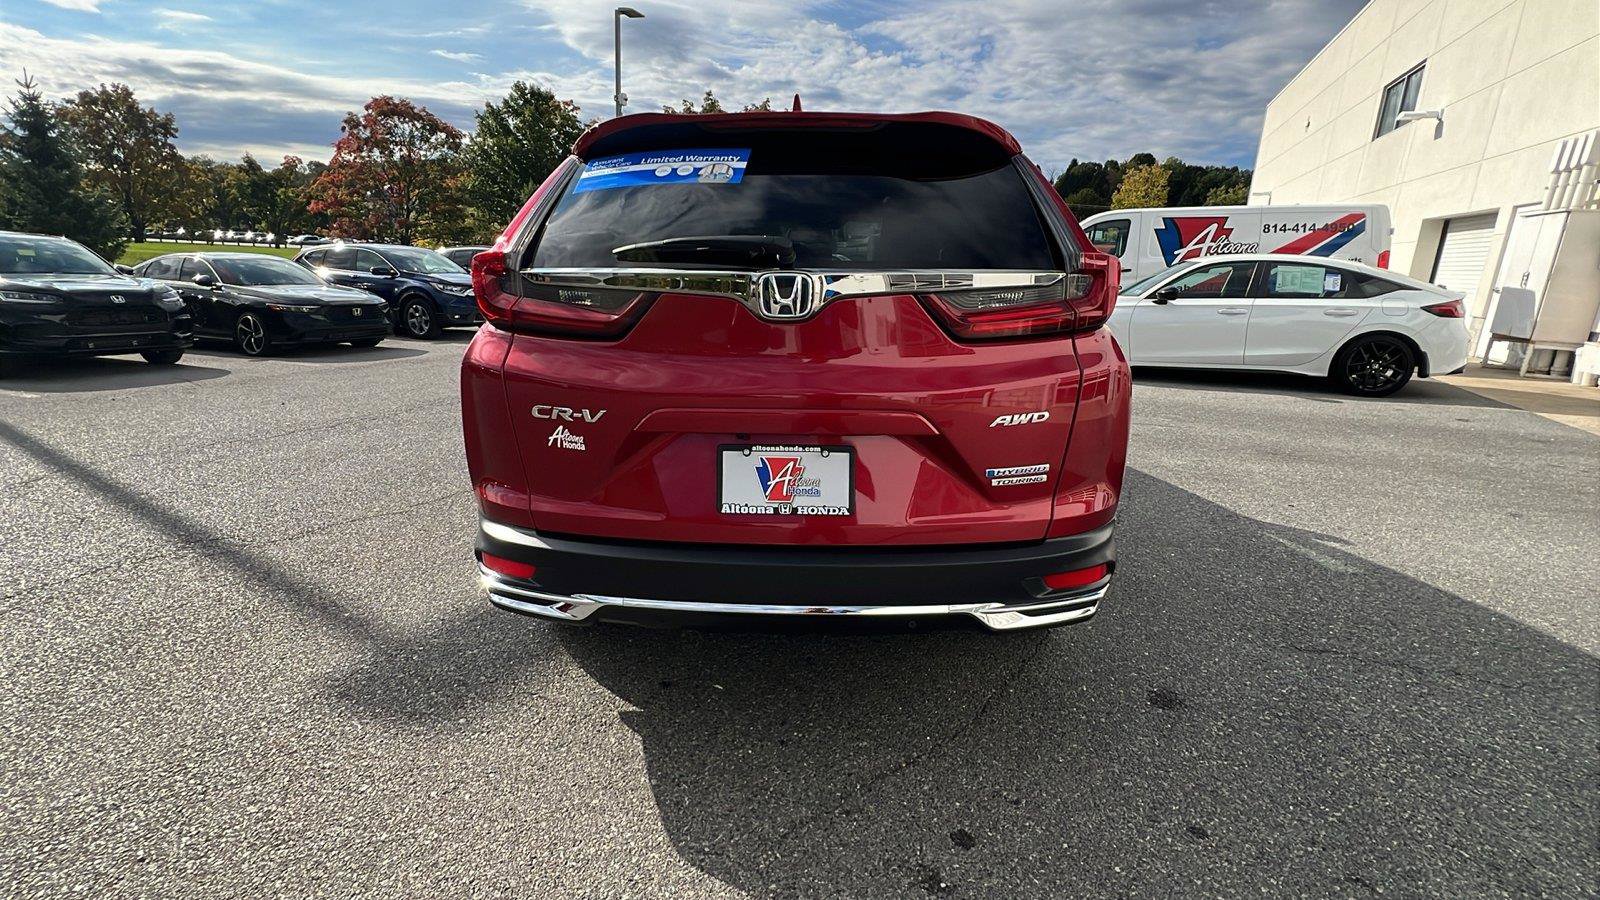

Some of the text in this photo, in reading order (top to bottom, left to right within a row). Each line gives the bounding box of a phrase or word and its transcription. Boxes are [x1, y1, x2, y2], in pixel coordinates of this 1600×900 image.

[641, 155, 740, 164] Limited Warranty
[1262, 224, 1355, 234] 814-414-4950
[1171, 222, 1258, 266] Altoona
[532, 404, 607, 422] CR-V
[989, 411, 1050, 428] AWD
[548, 425, 584, 448] Altoona
[563, 440, 586, 450] Honda
[996, 466, 1047, 476] HYBRID
[766, 461, 821, 496] Altoona
[996, 477, 1043, 486] TOURING
[788, 486, 820, 496] Honda
[721, 503, 850, 515] Altoona HONDA
